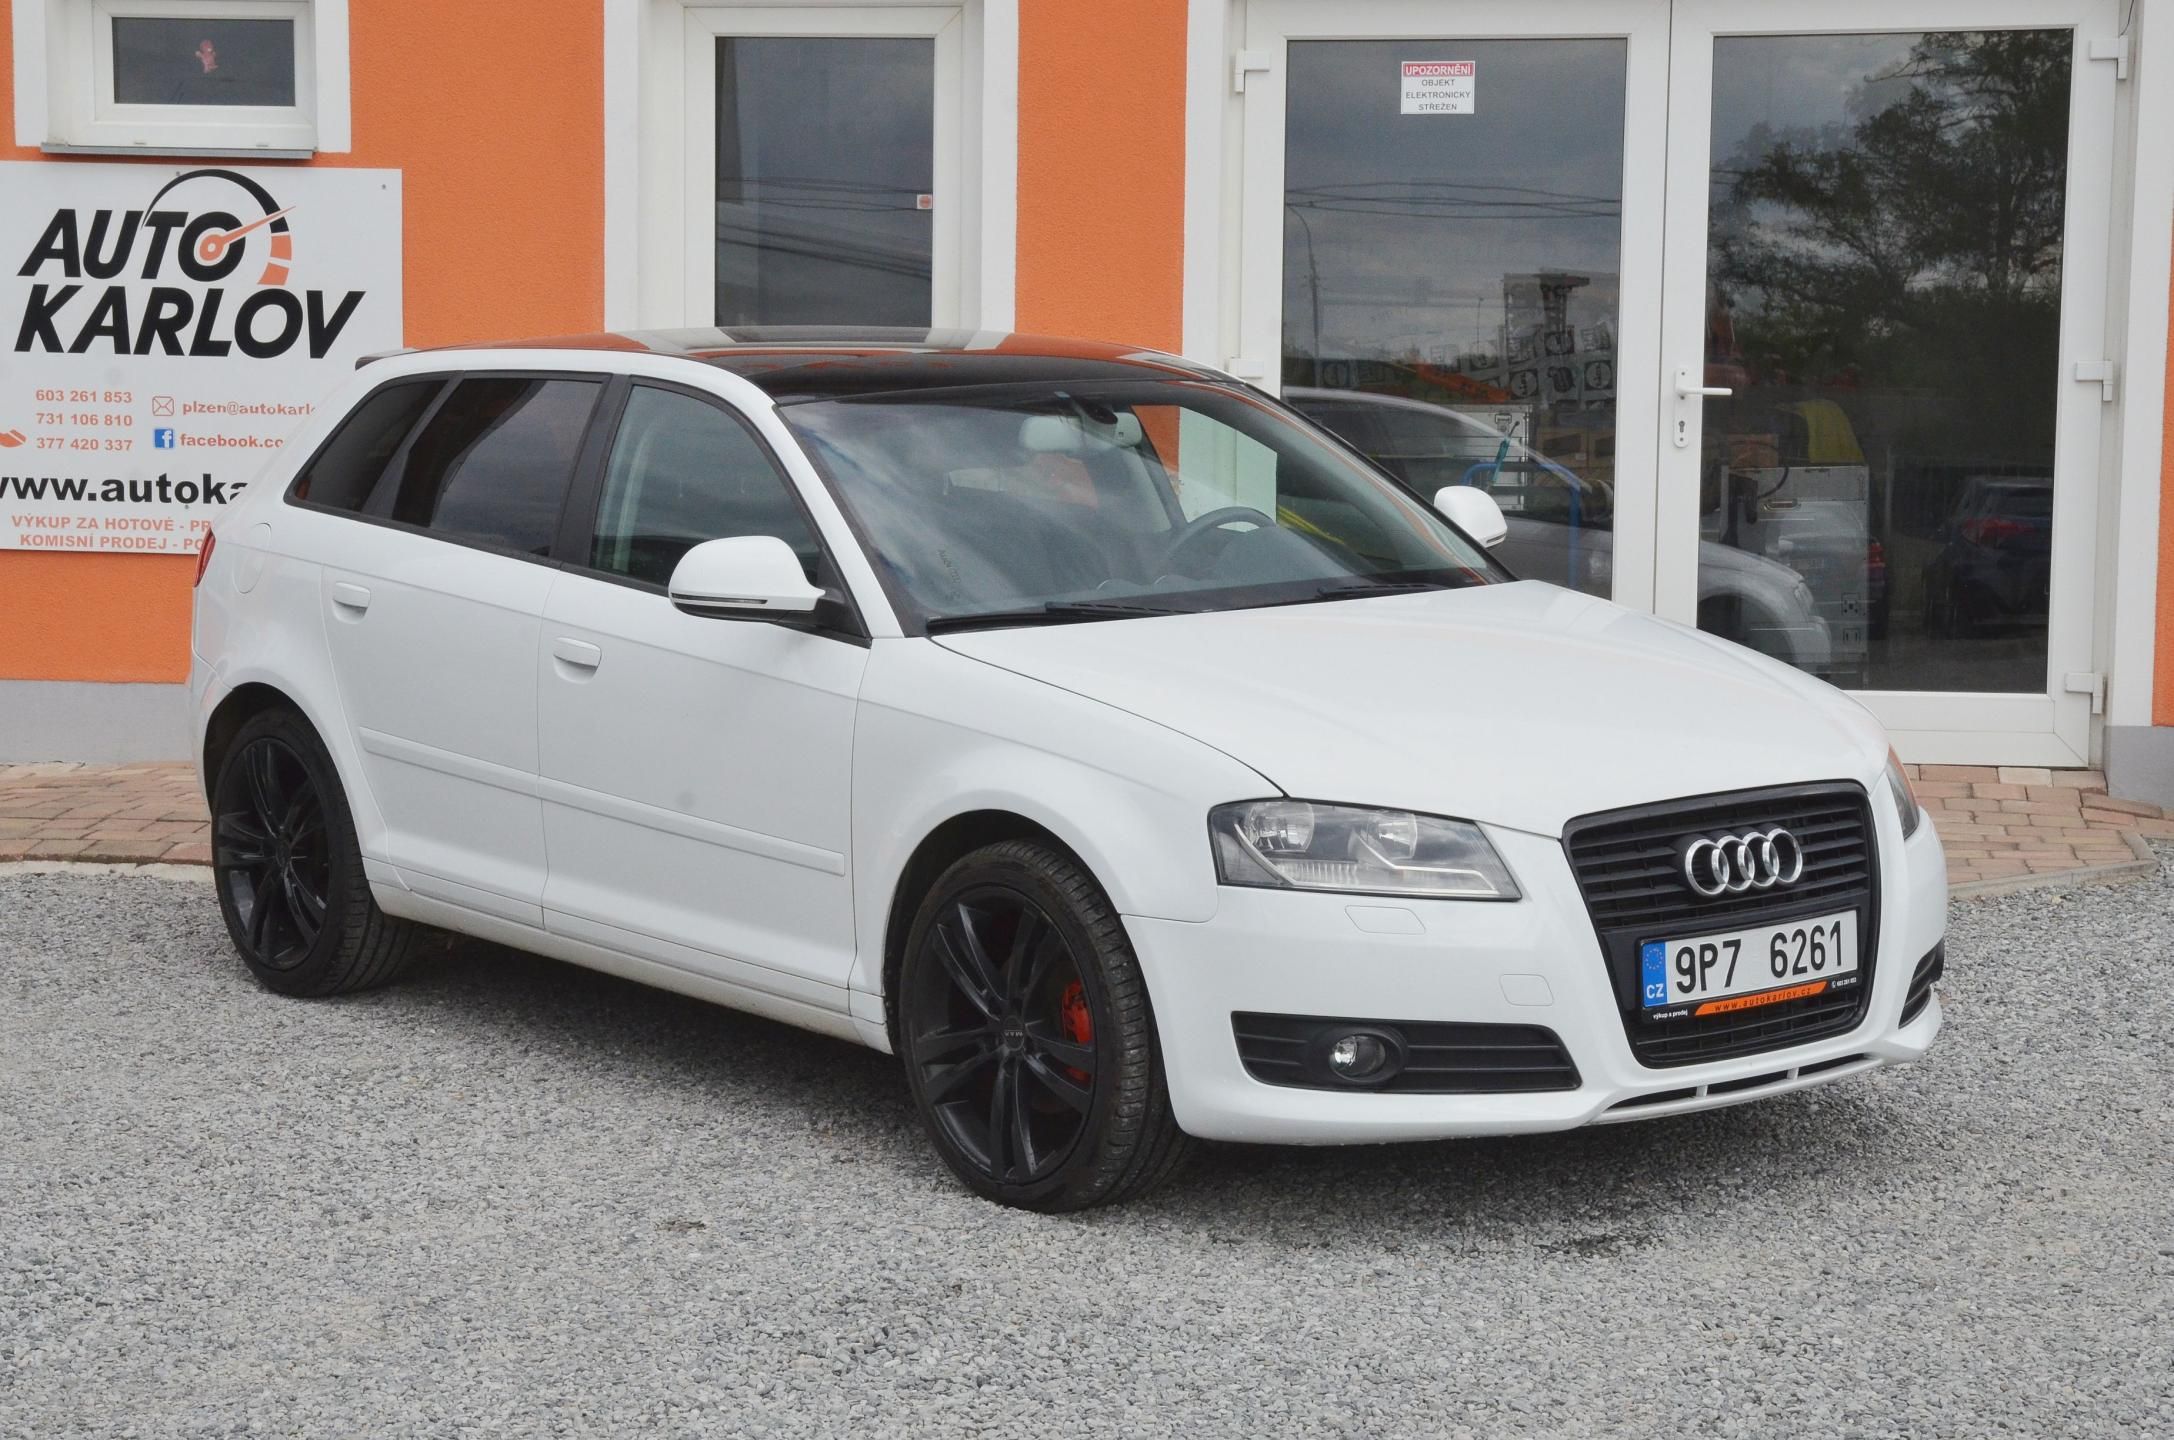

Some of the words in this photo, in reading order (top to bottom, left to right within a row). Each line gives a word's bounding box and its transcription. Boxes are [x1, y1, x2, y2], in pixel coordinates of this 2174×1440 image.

[1405, 63, 1471, 76] UPOZORNĚNÍ
[1421, 79, 1456, 87] OBJEKT
[1405, 91, 1471, 99] ELEKTRONICKY
[1418, 102, 1458, 111] STŘEŽEN
[17, 208, 246, 282] AUTO
[14, 284, 366, 359] KARLOV
[36, 389, 64, 401] 603
[70, 390, 97, 402] 261
[104, 391, 132, 403] 853
[36, 413, 63, 424] 731
[71, 414, 98, 426] 106
[104, 415, 132, 426] 810
[36, 438, 64, 449] 377
[70, 438, 99, 450] 420
[104, 440, 132, 451] 337
[0, 473, 248, 504] ww.autok
[11, 514, 70, 529] VÝKUP
[76, 517, 98, 529] ZA
[105, 517, 174, 531] HOTOVÉ
[20, 533, 93, 547] KOMISNÍ
[101, 536, 167, 549] PRODEJ
[1675, 938, 1742, 994] 9P7
[1769, 920, 1842, 979] 6261
[1646, 984, 1664, 999] CZ
[1714, 986, 1812, 1012] www.autokarlov.cz
